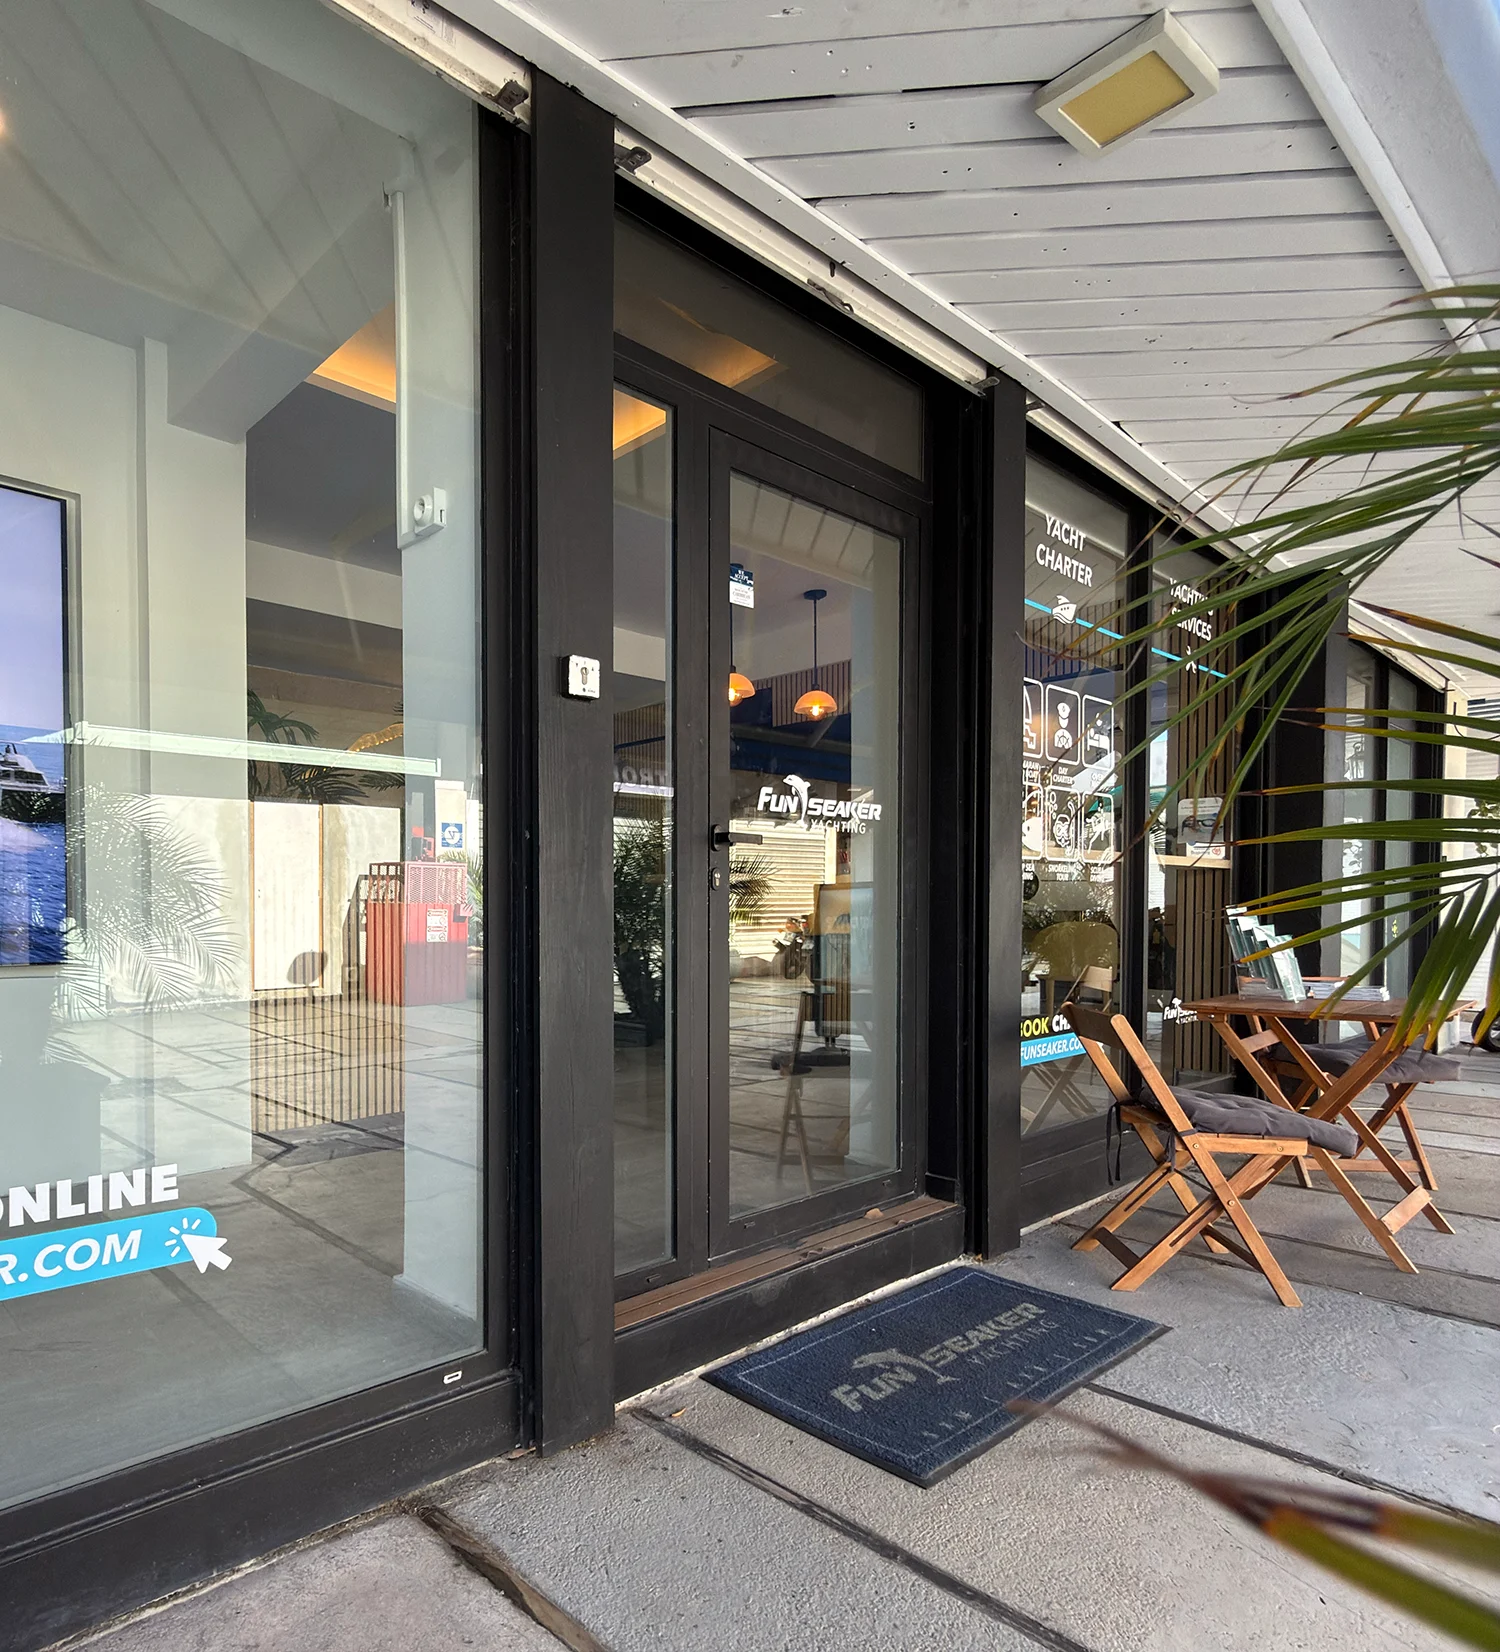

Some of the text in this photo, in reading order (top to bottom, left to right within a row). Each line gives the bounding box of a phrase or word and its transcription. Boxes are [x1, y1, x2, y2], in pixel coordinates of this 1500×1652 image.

[1045, 513, 1086, 552] YACHT
[1036, 543, 1093, 588] CHARTER
[1057, 766, 1068, 775] DAY
[757, 786, 882, 821] FUN SEAKER
[810, 818, 867, 835] YACHTING
[1052, 1014, 1071, 1033] CH
[1021, 1037, 1084, 1061] FUNSEAKER.CO
[0, 1163, 179, 1228] NLINE
[830, 1366, 918, 1413] FUN
[920, 1302, 1047, 1367] SEAKER
